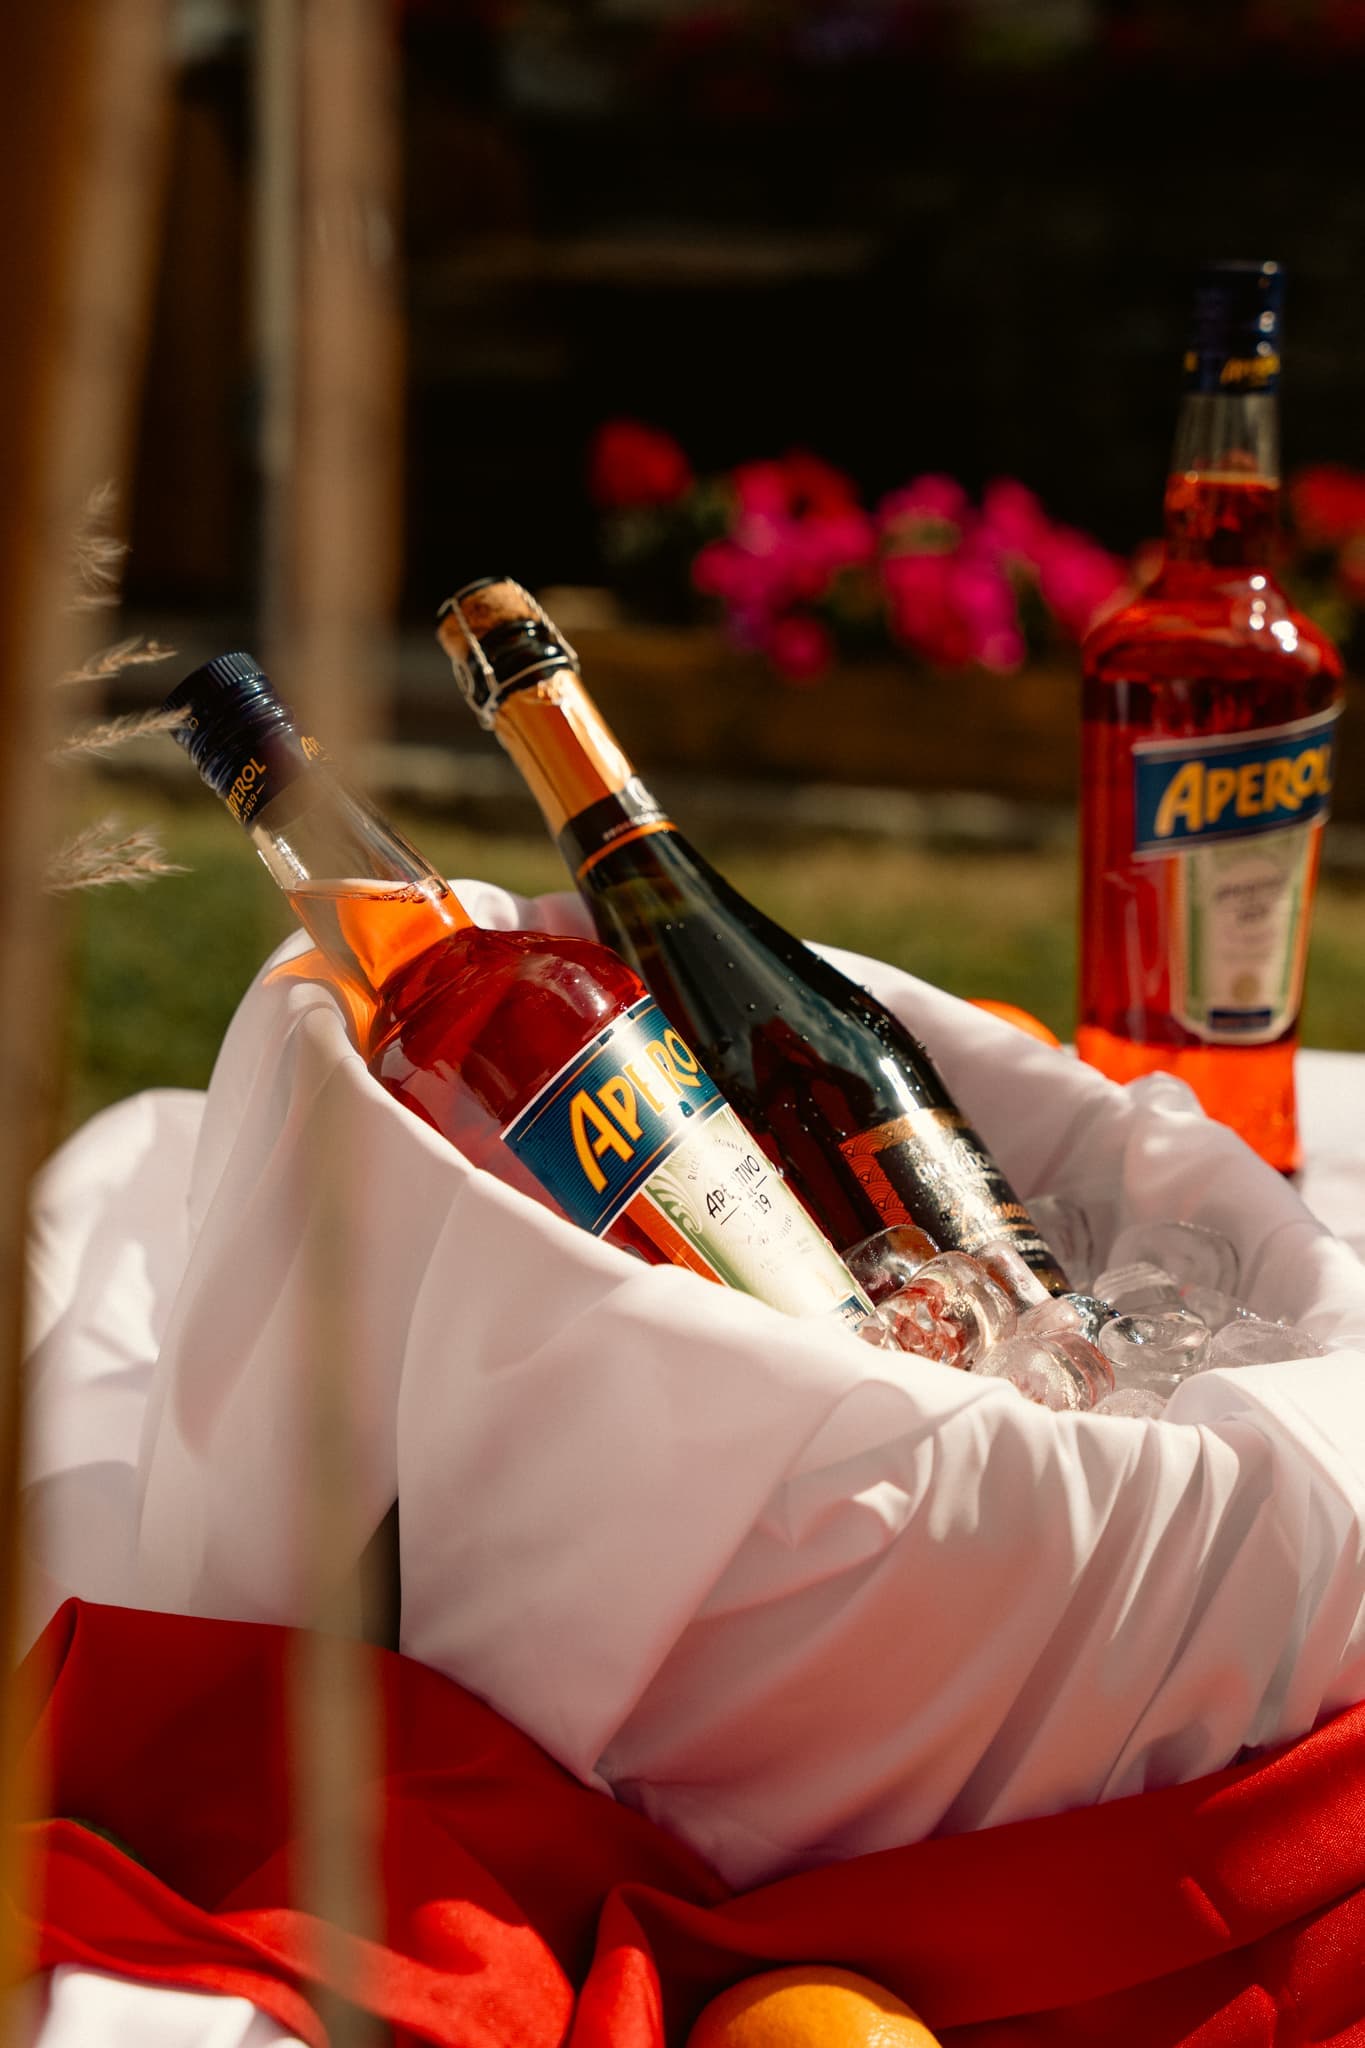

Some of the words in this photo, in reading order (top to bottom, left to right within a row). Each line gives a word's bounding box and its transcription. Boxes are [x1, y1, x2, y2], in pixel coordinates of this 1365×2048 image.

[224, 757, 267, 823] APEROL
[1154, 744, 1332, 838] APEROL
[569, 1027, 706, 1194] APERO
